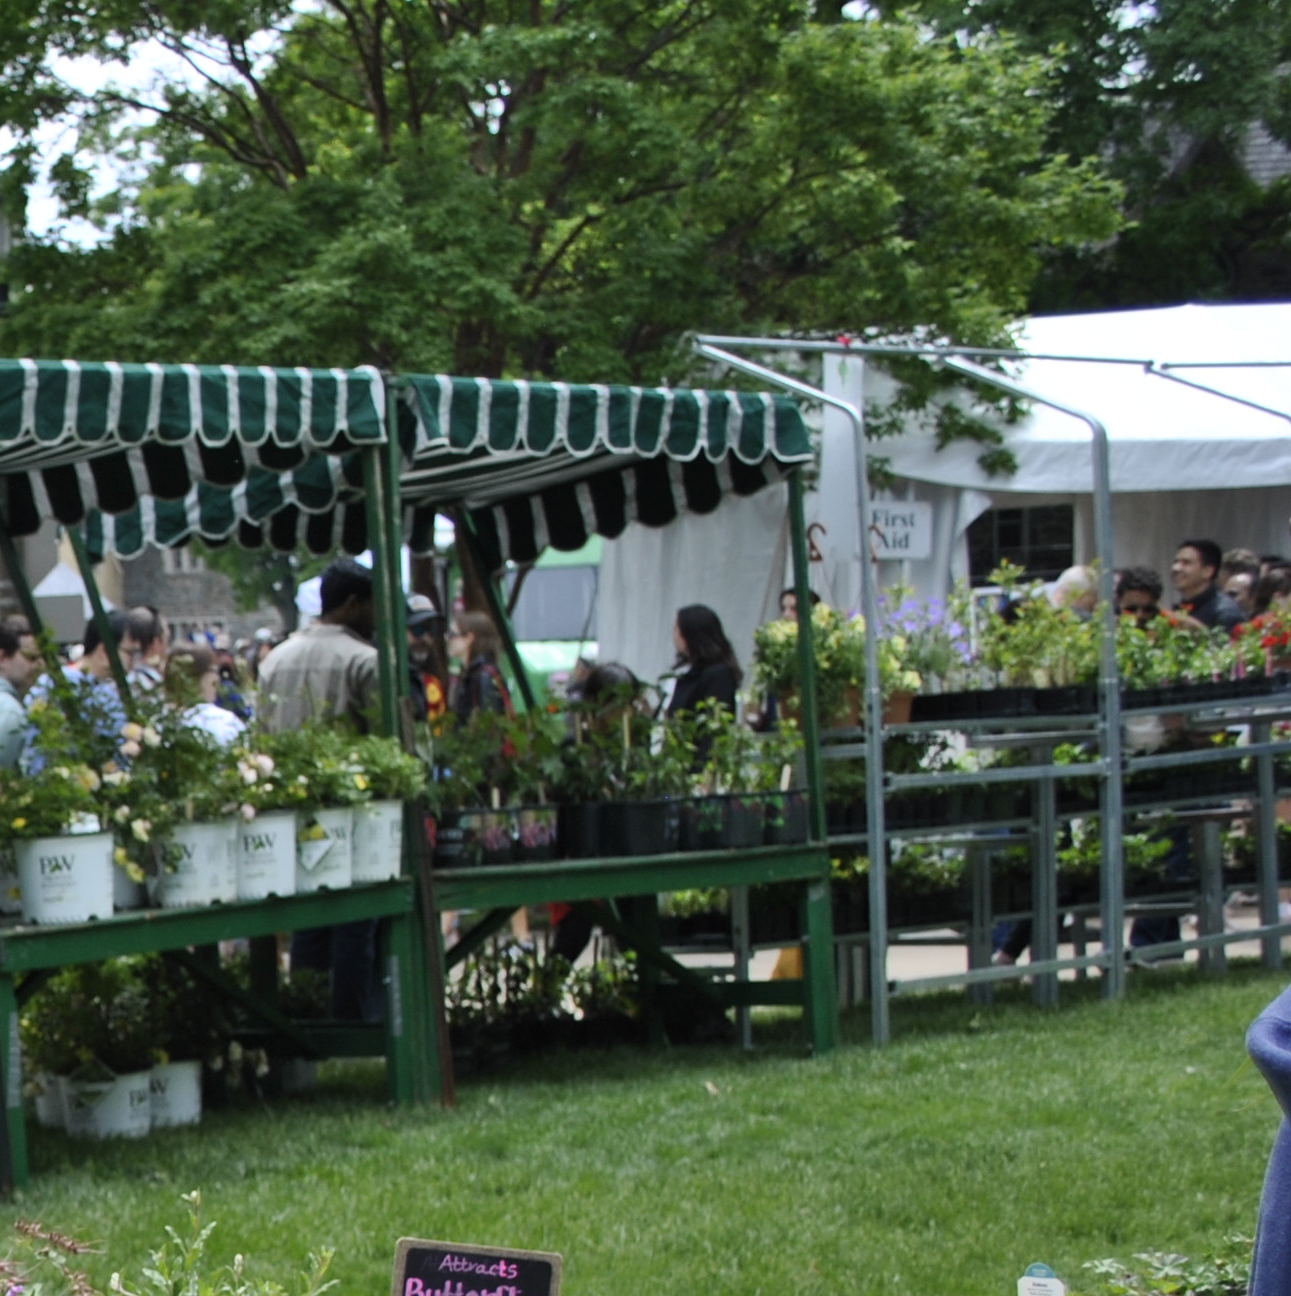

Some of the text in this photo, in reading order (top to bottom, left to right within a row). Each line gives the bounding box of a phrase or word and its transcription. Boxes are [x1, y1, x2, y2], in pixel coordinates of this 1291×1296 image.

[871, 509, 915, 527] First
[876, 531, 910, 549] Aid
[438, 1253, 519, 1279] Attracts
